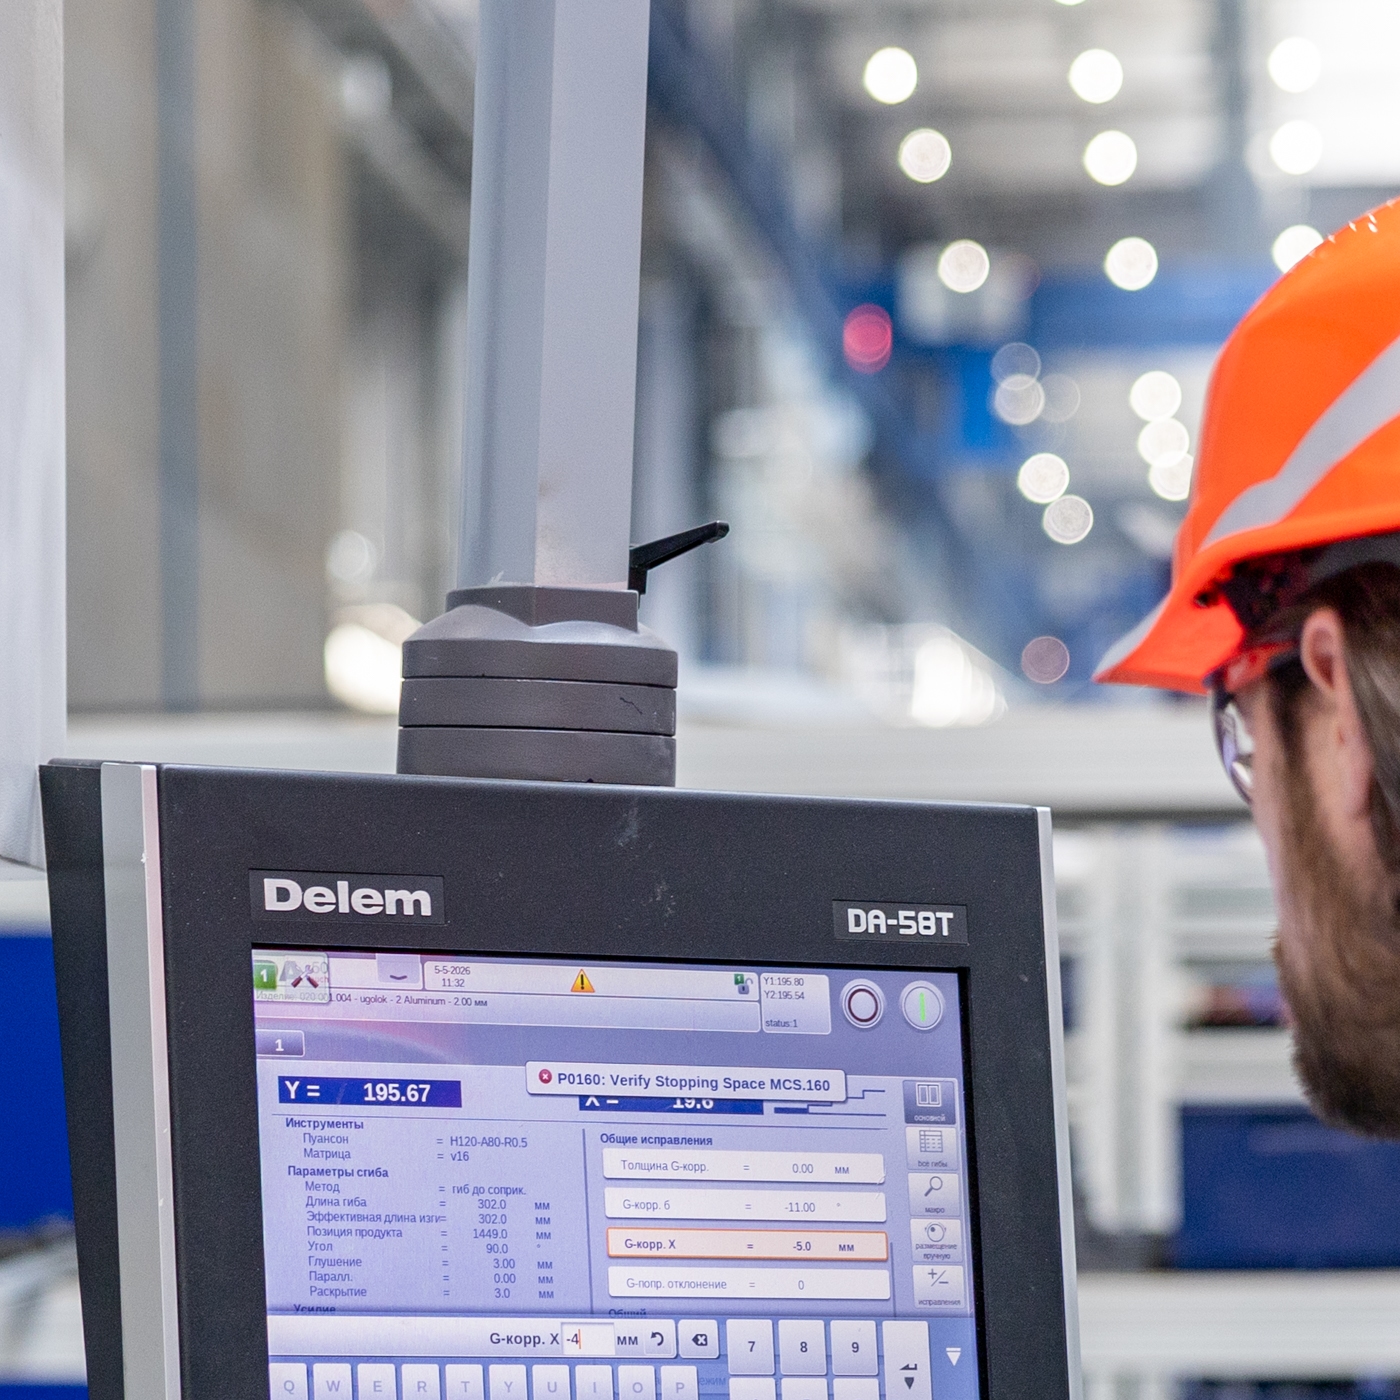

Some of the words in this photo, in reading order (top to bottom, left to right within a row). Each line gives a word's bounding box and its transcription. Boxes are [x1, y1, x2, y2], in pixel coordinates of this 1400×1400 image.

[263, 877, 433, 917] Delem
[846, 908, 954, 937] DA-58T
[259, 969, 269, 983] 1
[434, 966, 471, 975] 5-5-2026
[442, 978, 465, 988] 11:32
[764, 977, 804, 987] Y1:195.80
[360, 995, 387, 1006] ugolok
[396, 996, 401, 1004] 2
[404, 996, 445, 1006] Aluminum
[454, 997, 472, 1006] 2.00
[765, 990, 805, 1000] Y2:195.54
[765, 1018, 798, 1028] status:1
[274, 1039, 284, 1051] 1
[559, 1073, 606, 1086] P0160:
[610, 1074, 651, 1090] Verify
[656, 1075, 719, 1091] Stopping
[722, 1077, 766, 1092] Space
[770, 1078, 830, 1092] MCS.160
[285, 1080, 299, 1099] Y
[363, 1083, 430, 1102] 195.67
[285, 1118, 364, 1131] Инструменты
[303, 1133, 349, 1146] Пуансон
[450, 1136, 528, 1148] H120-A80-R0.5
[600, 1133, 638, 1146] Общие
[641, 1135, 713, 1147] исправления
[304, 1149, 351, 1160] Матрица
[450, 1151, 469, 1162] v16
[288, 1166, 354, 1180] Параметры
[357, 1168, 389, 1178] сгиба
[621, 1160, 668, 1174] Толщина
[671, 1161, 709, 1174] G-корр.
[792, 1163, 814, 1174] 0.00
[834, 1166, 850, 1174] мм
[305, 1182, 340, 1194] Метод
[452, 1185, 470, 1194] гиб
[472, 1186, 485, 1197] до
[487, 1186, 526, 1198] соприк.
[306, 1197, 340, 1208] Длина
[343, 1197, 367, 1207] гиба
[478, 1199, 506, 1210] 302.0
[623, 1199, 661, 1213] G-корр.
[784, 1202, 816, 1213] -11.00
[307, 1212, 381, 1224] Эффективная
[384, 1213, 417, 1225] длина
[478, 1214, 507, 1225] 302.0
[535, 1217, 551, 1225] мм
[307, 1226, 352, 1239] Позиция
[355, 1228, 403, 1239] продукта
[473, 1229, 508, 1239] 1449.0
[307, 1241, 333, 1252] Угол
[486, 1243, 508, 1254] 90.0
[625, 1239, 666, 1252] G-корр.
[793, 1241, 812, 1252] -5.0
[838, 1243, 855, 1252] мм
[308, 1256, 362, 1268] Глушение
[493, 1259, 515, 1269] 3.00
[309, 1271, 353, 1282] Паралл.
[494, 1273, 516, 1284] 0.00
[538, 1276, 553, 1284] мм
[309, 1286, 367, 1298] Раскрытие
[495, 1288, 510, 1298] 3.0
[626, 1278, 665, 1293] G-попр.
[668, 1279, 727, 1290] отклонение
[798, 1280, 805, 1290] 0
[490, 1332, 545, 1349] G-корр.
[566, 1333, 579, 1345] -4
[617, 1335, 638, 1346] мм
[748, 1341, 756, 1353] 7
[800, 1342, 808, 1353] 8
[851, 1342, 859, 1353] 9
[283, 1380, 295, 1394] Q
[326, 1380, 341, 1392] W
[373, 1380, 382, 1393] E
[417, 1381, 427, 1393] R
[461, 1381, 470, 1393] T
[503, 1381, 513, 1393] Y
[547, 1381, 557, 1394] U
[675, 1382, 685, 1394] P
